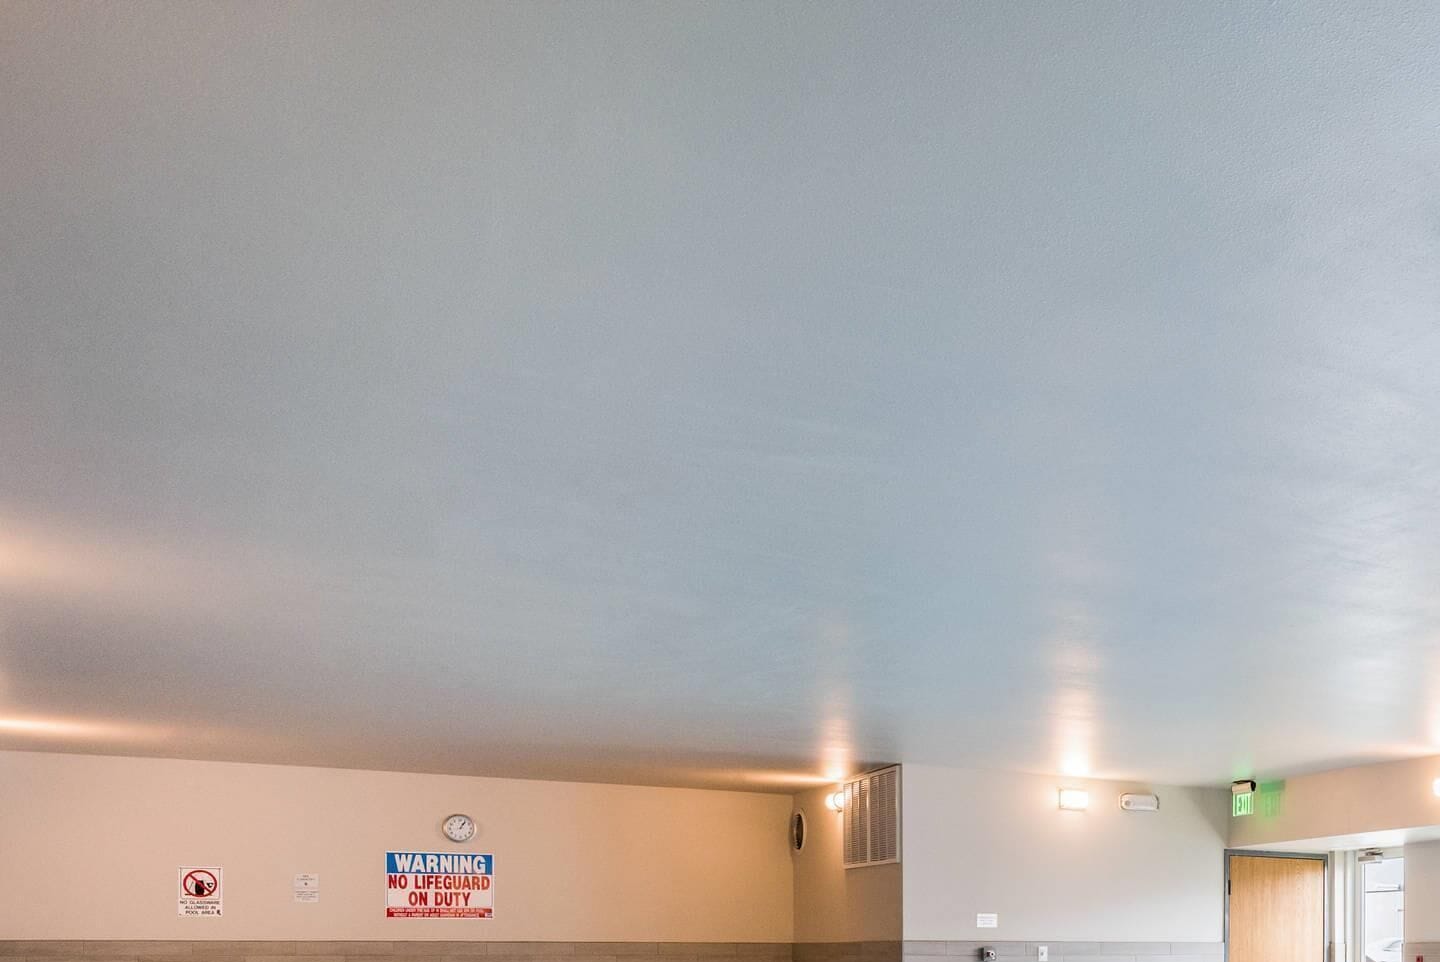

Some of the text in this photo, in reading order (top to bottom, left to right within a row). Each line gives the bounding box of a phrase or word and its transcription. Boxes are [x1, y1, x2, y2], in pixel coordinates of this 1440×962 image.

[1236, 793, 1251, 816] EXIT
[394, 853, 486, 874] WARNING
[388, 874, 490, 890] NO LIFEGUARD
[408, 891, 472, 907] ON DUTY
